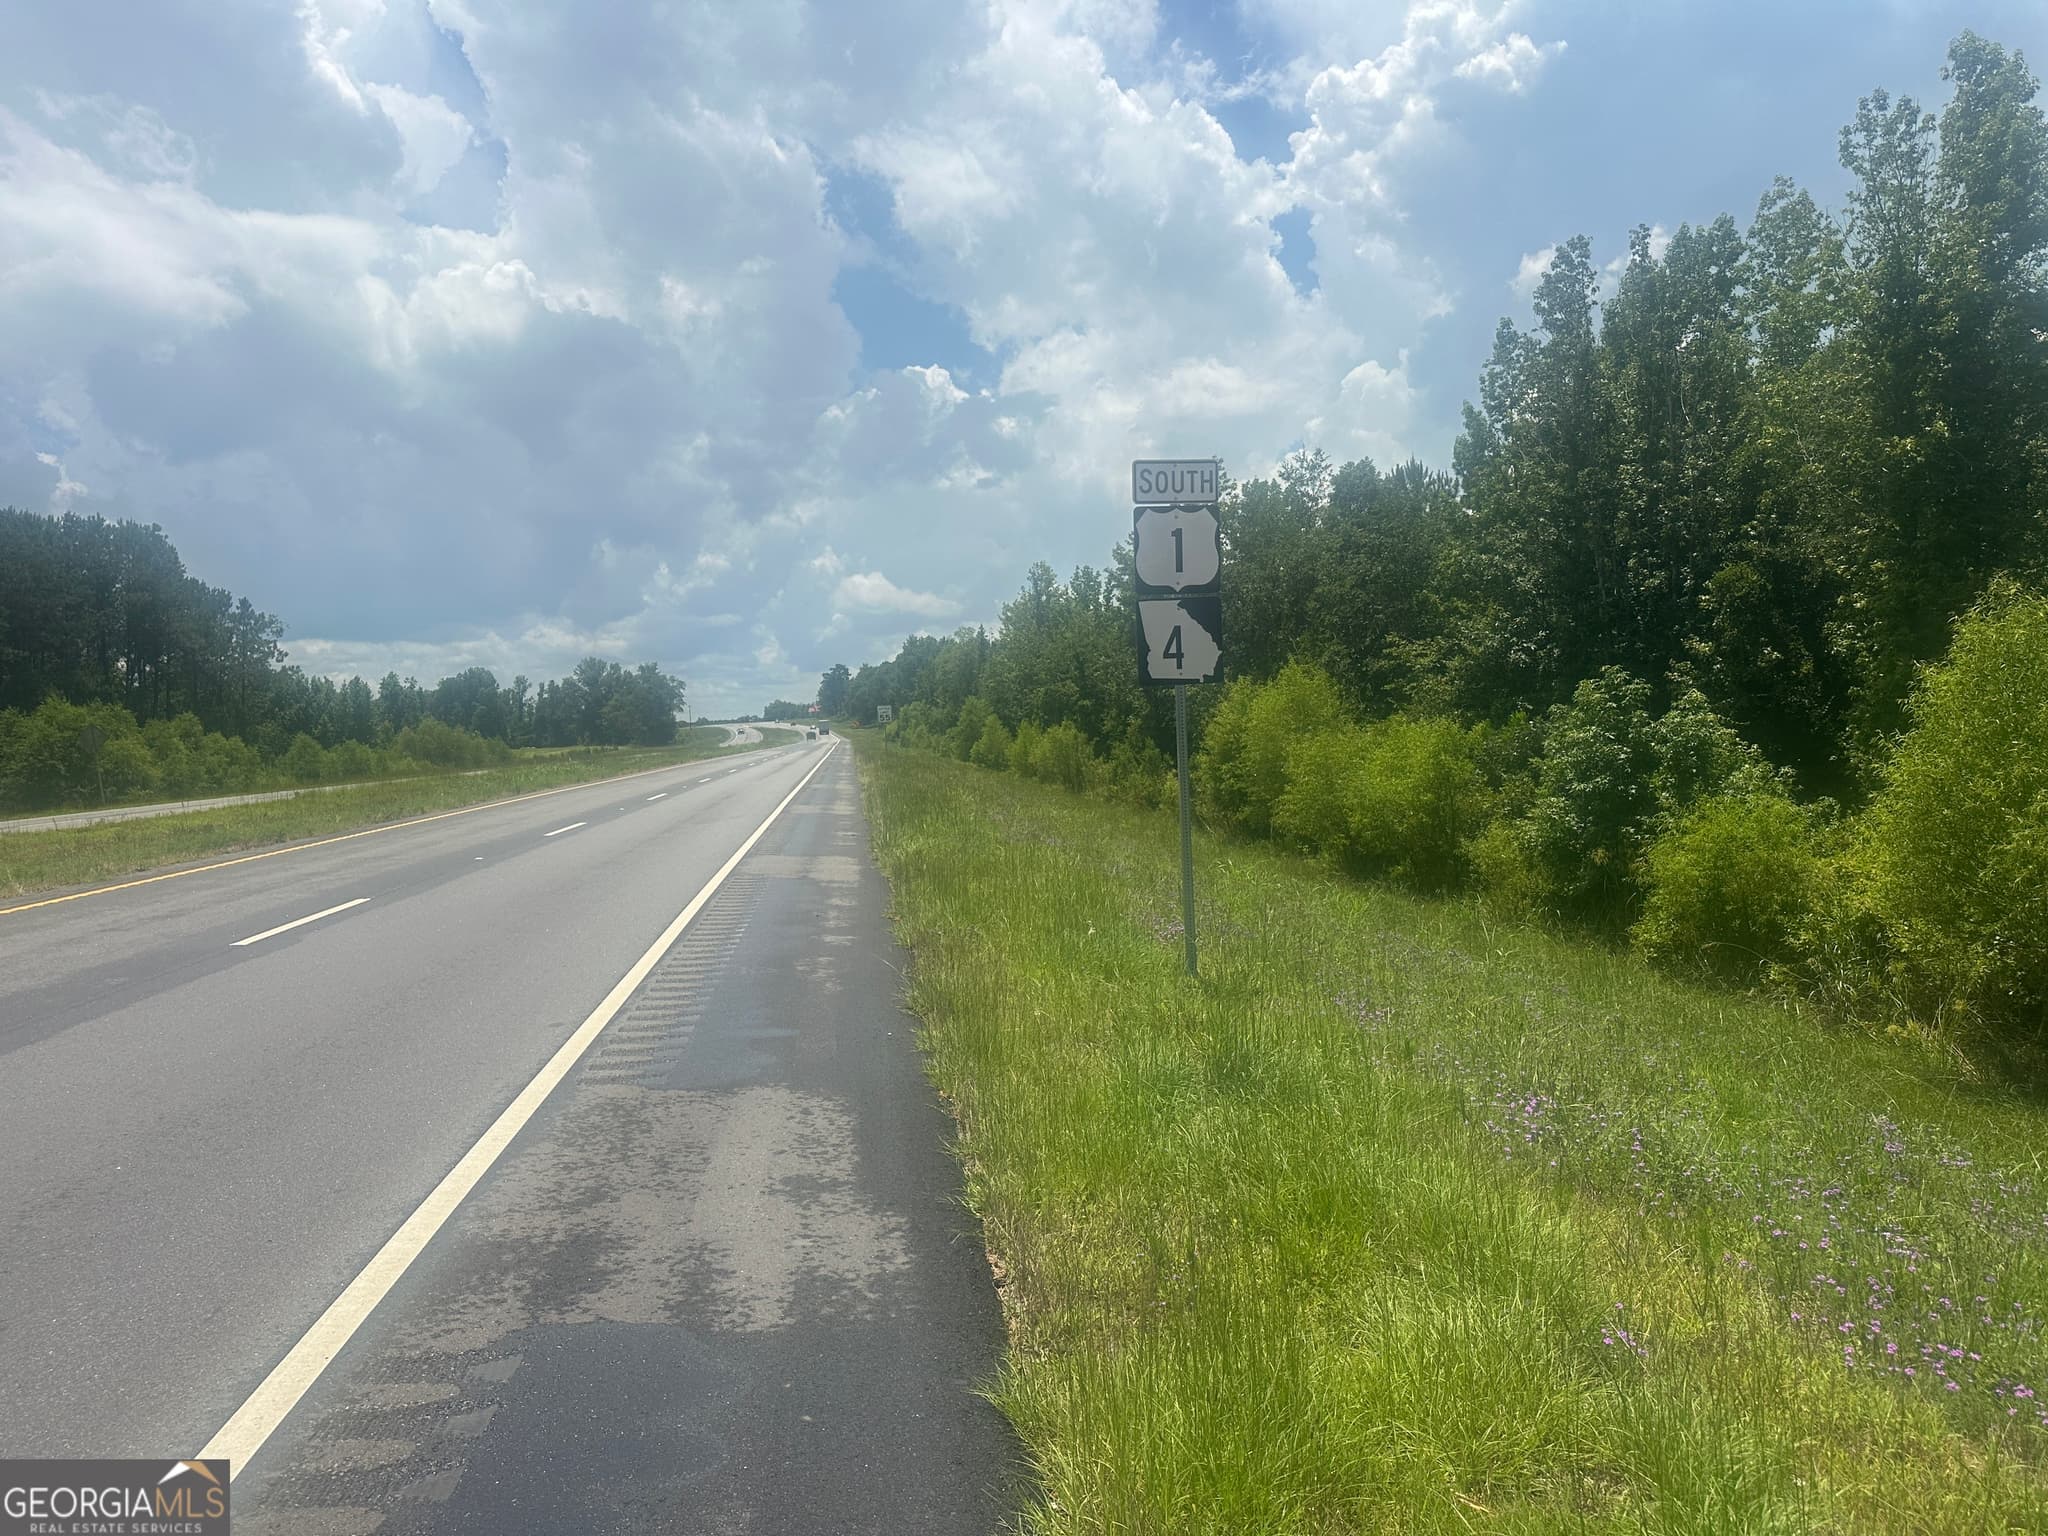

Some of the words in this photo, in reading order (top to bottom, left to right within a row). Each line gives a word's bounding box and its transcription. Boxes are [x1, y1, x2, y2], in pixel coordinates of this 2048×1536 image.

[1139, 468, 1213, 494] SOUTH
[1171, 527, 1184, 573] 1
[1163, 625, 1185, 670] 4
